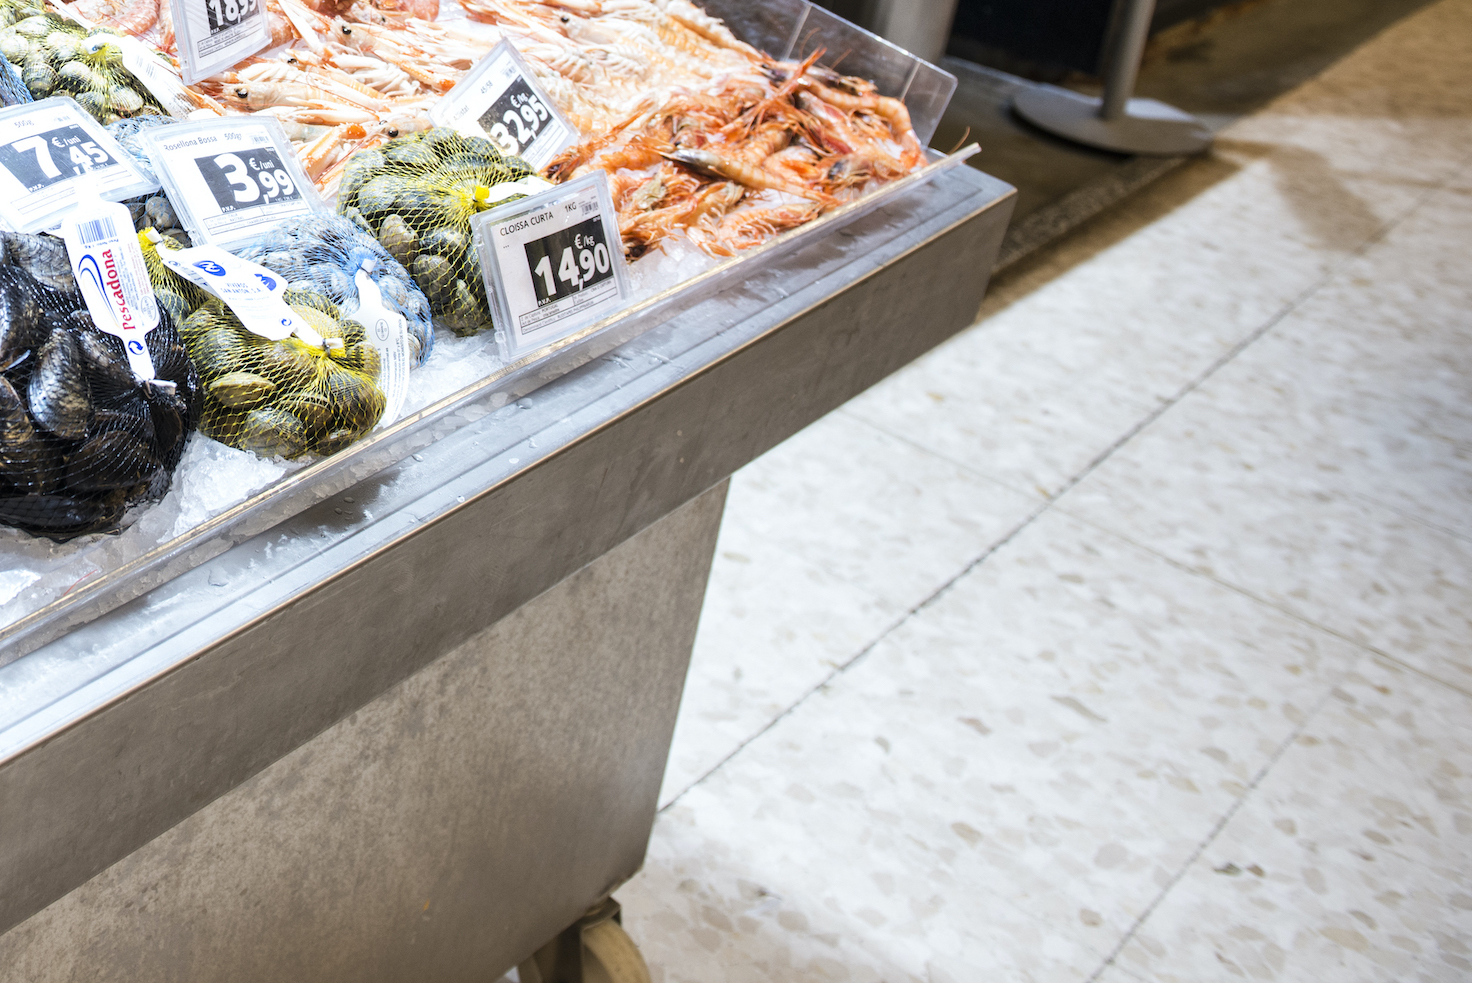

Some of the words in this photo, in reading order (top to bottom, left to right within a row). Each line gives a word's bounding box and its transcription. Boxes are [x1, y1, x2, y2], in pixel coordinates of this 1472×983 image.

[164, 137, 198, 151] Rosellona
[198, 135, 218, 145] Bossa
[490, 95, 548, 156] 32,95
[11, 136, 109, 180] 7,45
[214, 153, 294, 204] 3,99
[530, 211, 554, 226] CURTA
[565, 202, 577, 213] 1KG
[101, 249, 137, 330] Pescadona
[534, 242, 610, 296] 14,90
